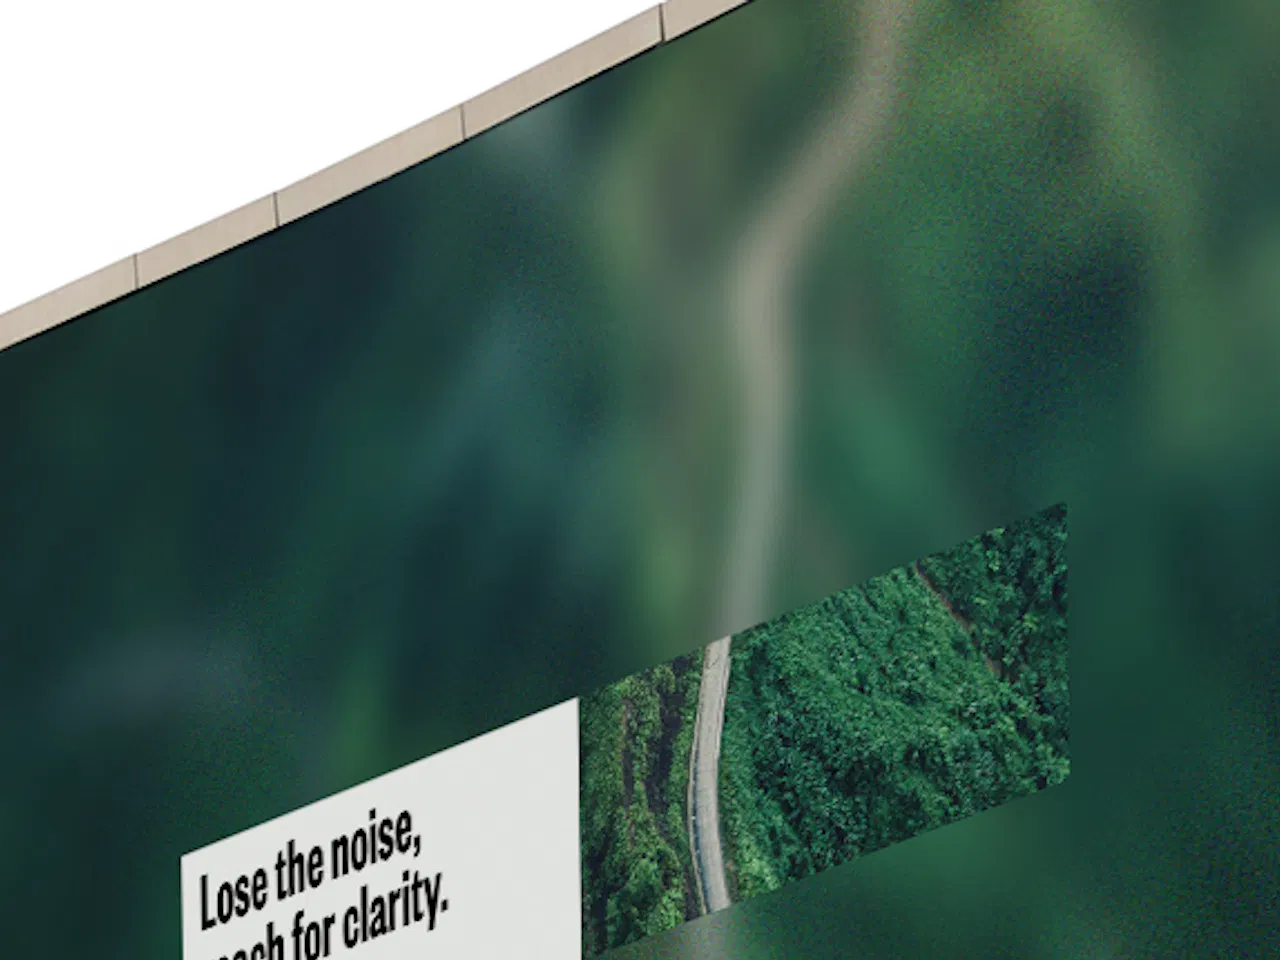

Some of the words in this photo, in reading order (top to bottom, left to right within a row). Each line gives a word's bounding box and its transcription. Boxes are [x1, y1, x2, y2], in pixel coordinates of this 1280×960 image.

[200, 867, 267, 930] Lose
[274, 838, 323, 901] the
[331, 808, 421, 879] noise,
[343, 870, 448, 948] clarity.
